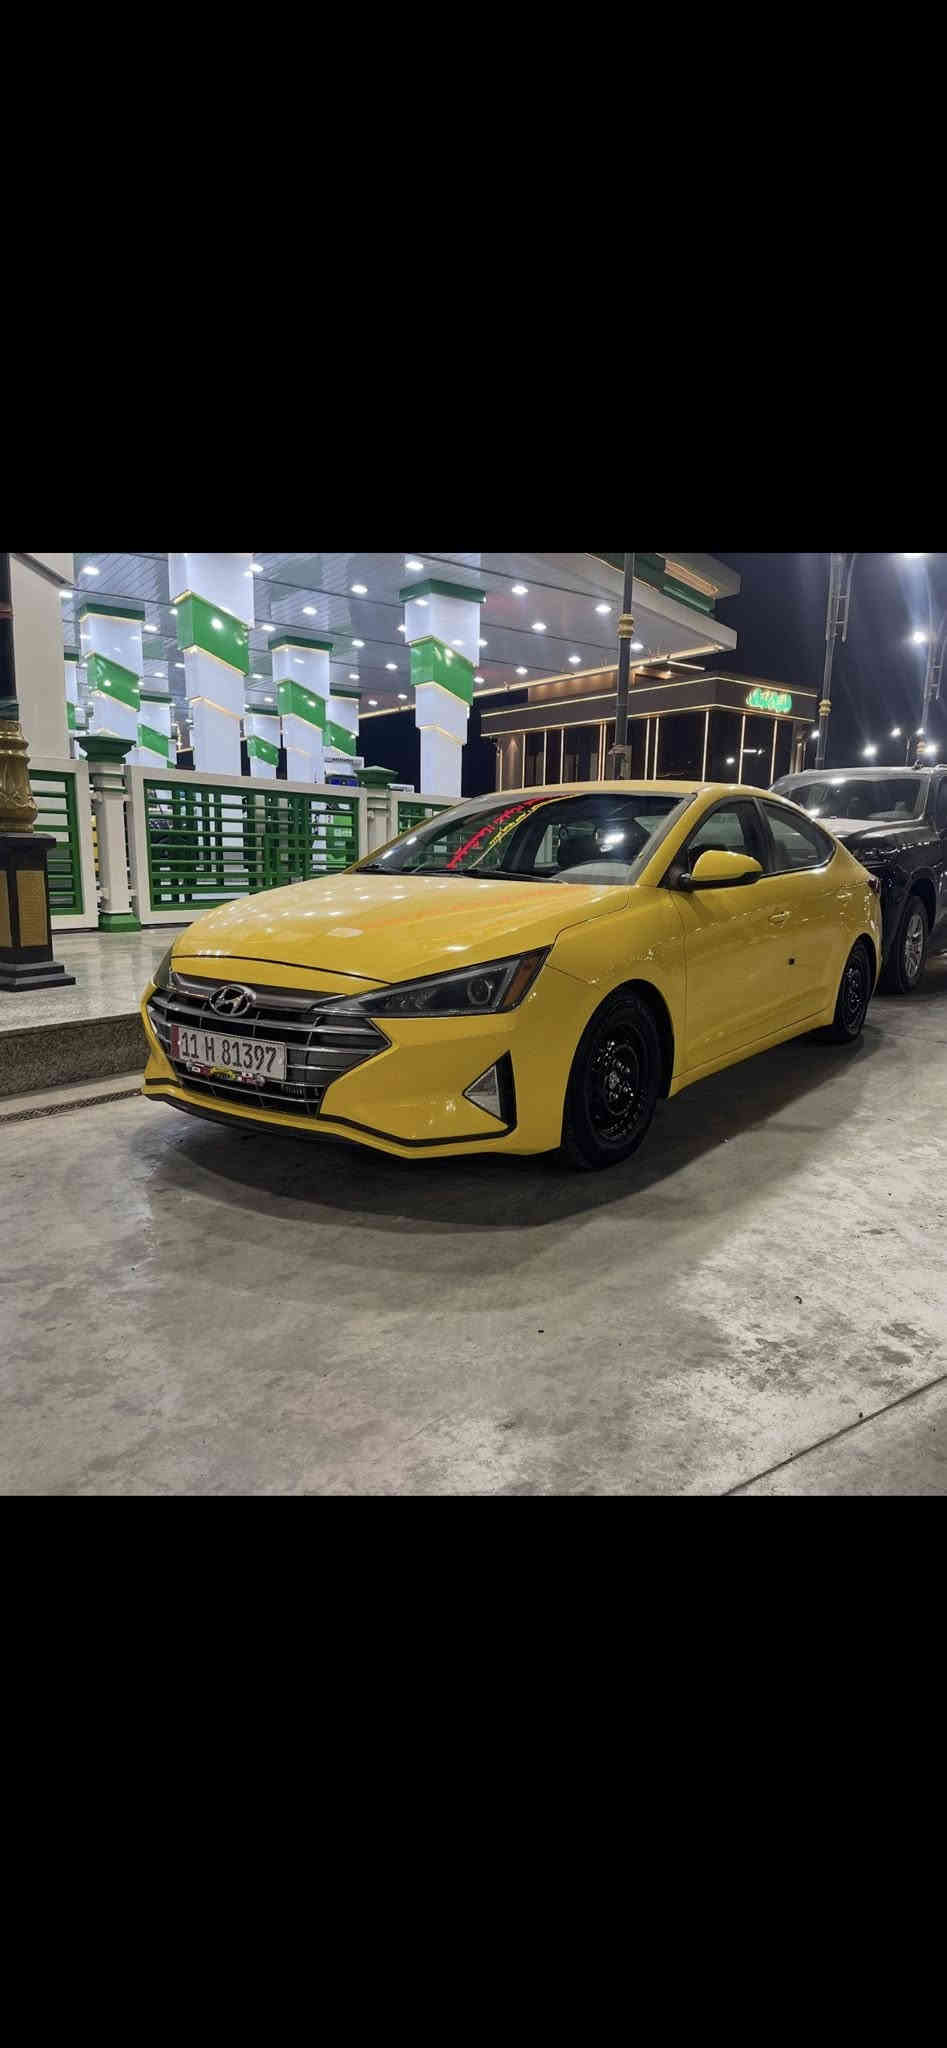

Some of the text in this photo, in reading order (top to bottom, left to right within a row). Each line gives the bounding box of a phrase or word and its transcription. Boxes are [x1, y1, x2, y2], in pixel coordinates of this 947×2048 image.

[182, 1032, 276, 1073] 11 H 81397
